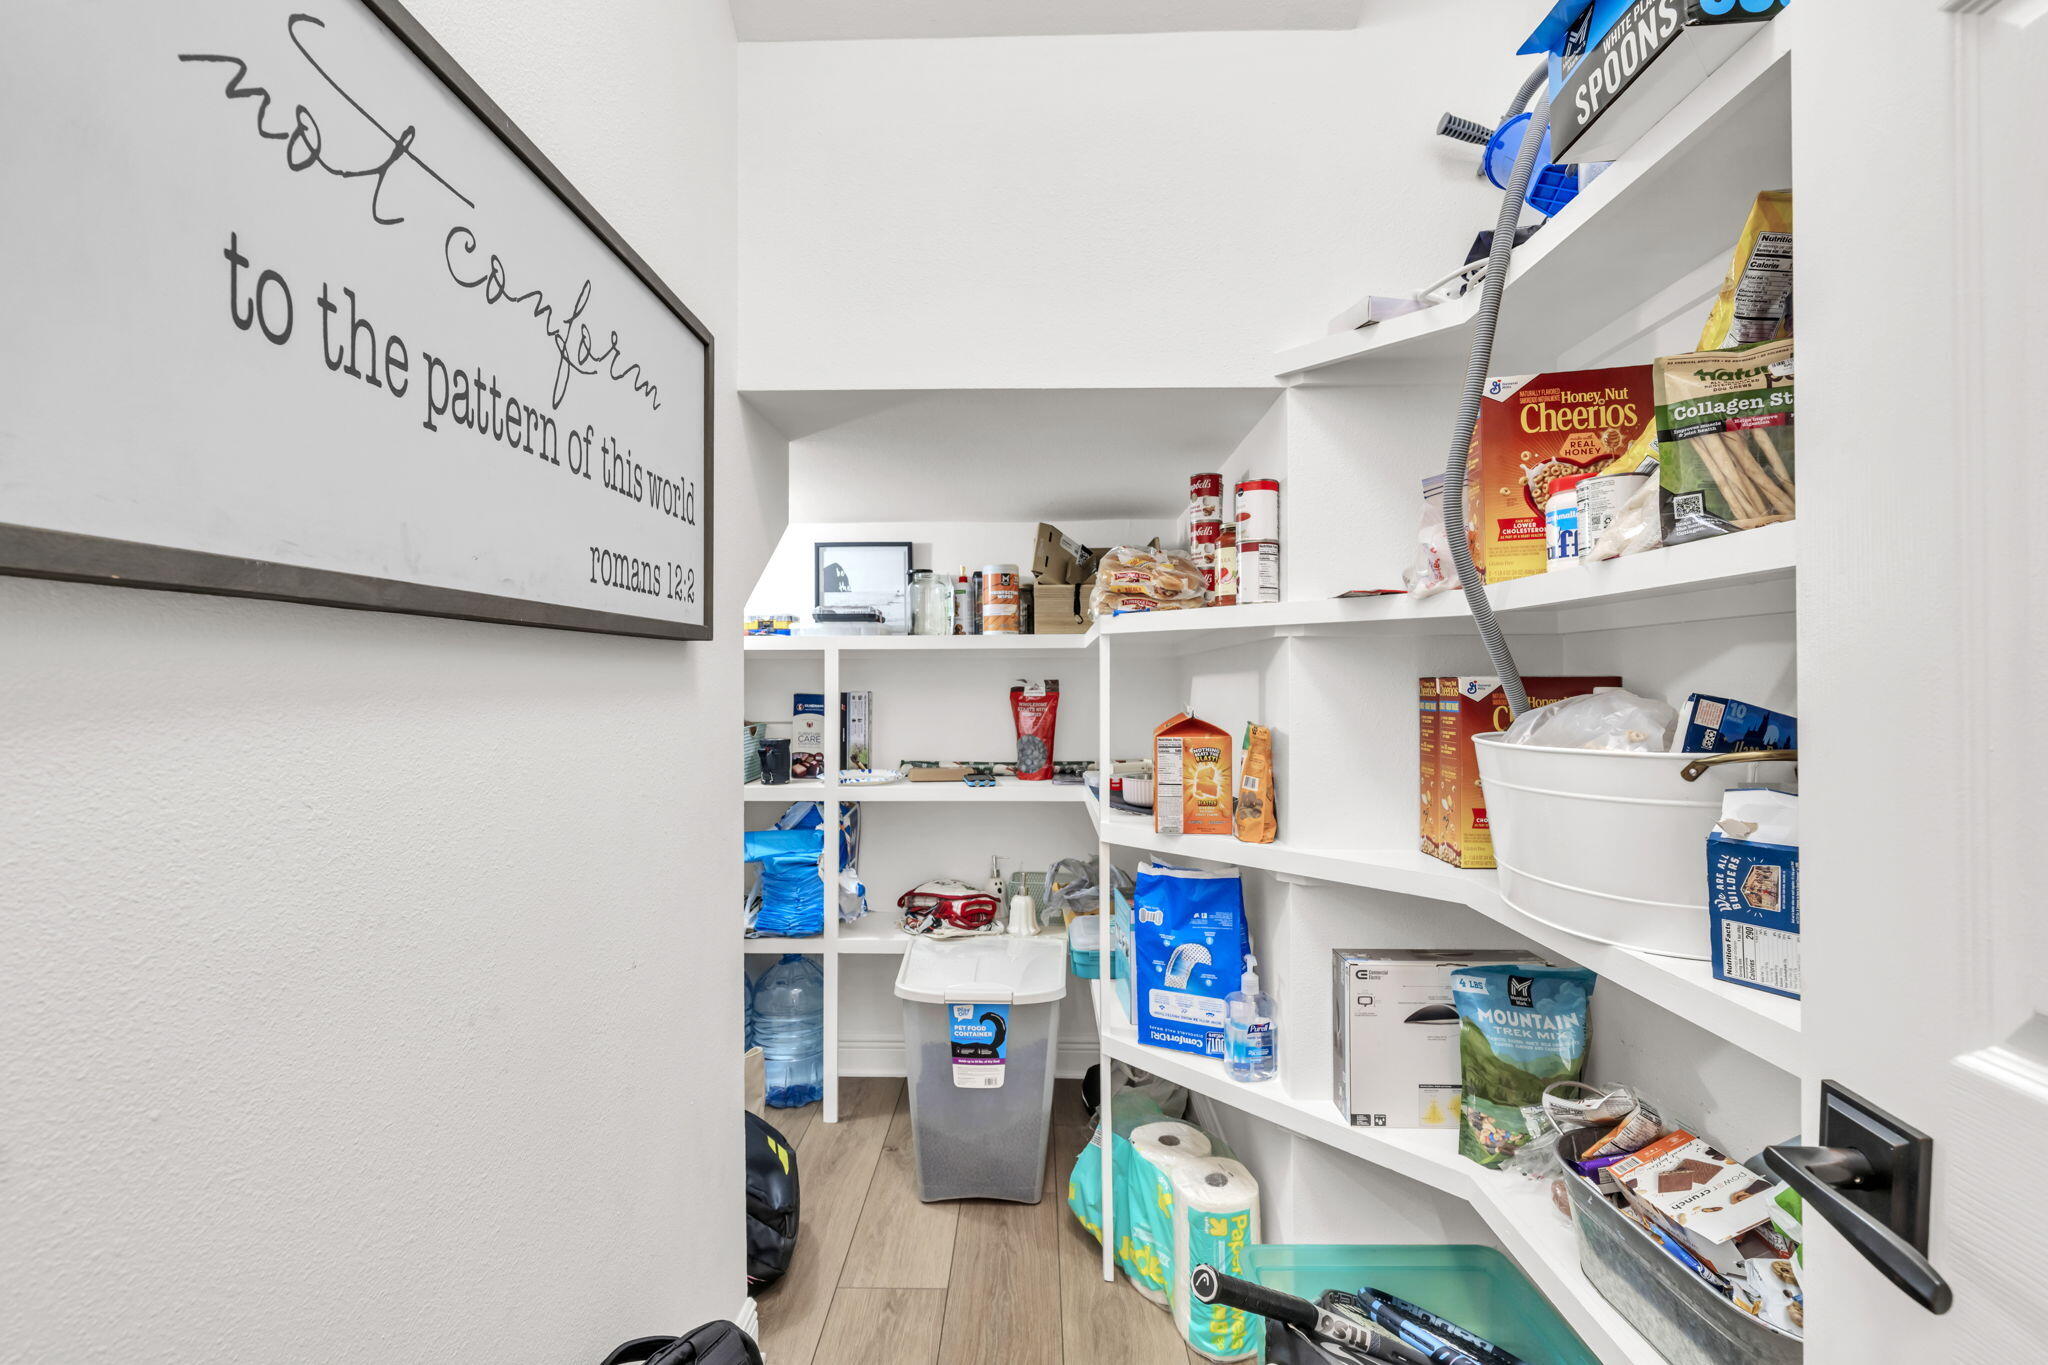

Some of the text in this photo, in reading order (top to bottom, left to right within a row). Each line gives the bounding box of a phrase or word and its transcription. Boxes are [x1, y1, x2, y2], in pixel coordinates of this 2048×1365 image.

[1602, 0, 1656, 54] WHITE PLA
[1575, 0, 1678, 125] SPOONS
[178, 13, 475, 225] not
[1760, 234, 1792, 244] Nutritio
[445, 226, 661, 410] conform
[223, 231, 696, 526] to the pattern of this world
[1561, 391, 1601, 405] Honey
[1604, 387, 1629, 400] Nut
[1673, 391, 1793, 422] Collagen St
[1520, 402, 1638, 434] Cheerios
[1564, 448, 1601, 456] HONEY
[1570, 440, 1596, 448] REAL
[588, 545, 696, 604] romans 12:2
[1730, 702, 1747, 719] 10
[797, 735, 821, 743] CARE
[1714, 854, 1733, 913] We ARE ALL
[1745, 926, 1754, 940] 290
[1459, 978, 1484, 990] 4 LBS
[1477, 1007, 1580, 1030] MOUNTAIN
[1494, 1025, 1532, 1039] TREK
[1671, 1188, 1712, 1211] crunch
[1228, 1214, 1249, 1350] Paper wels
